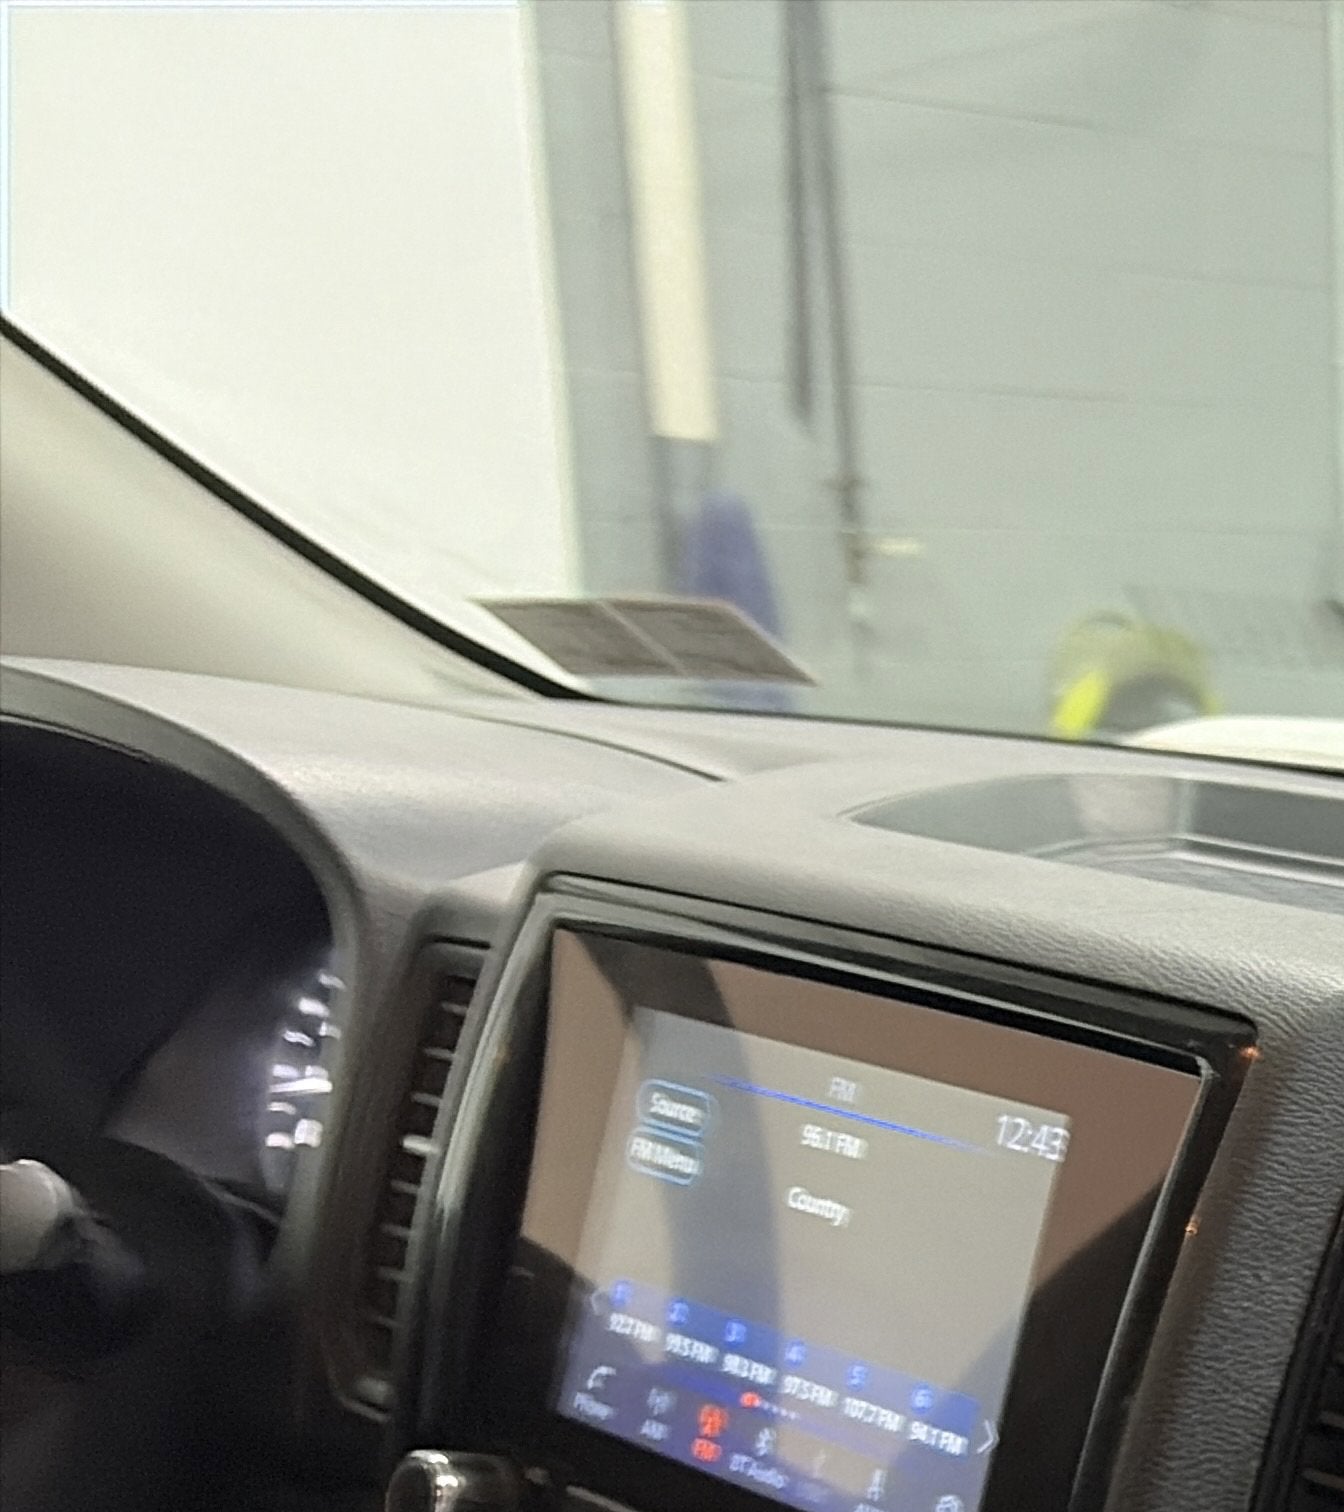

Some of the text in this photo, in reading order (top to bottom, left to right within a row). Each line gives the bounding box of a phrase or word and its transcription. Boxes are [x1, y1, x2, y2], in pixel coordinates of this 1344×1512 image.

[650, 1092, 701, 1124] Source
[834, 1132, 865, 1159] FM
[997, 1114, 1069, 1162] 12:43
[787, 1187, 849, 1227] Country
